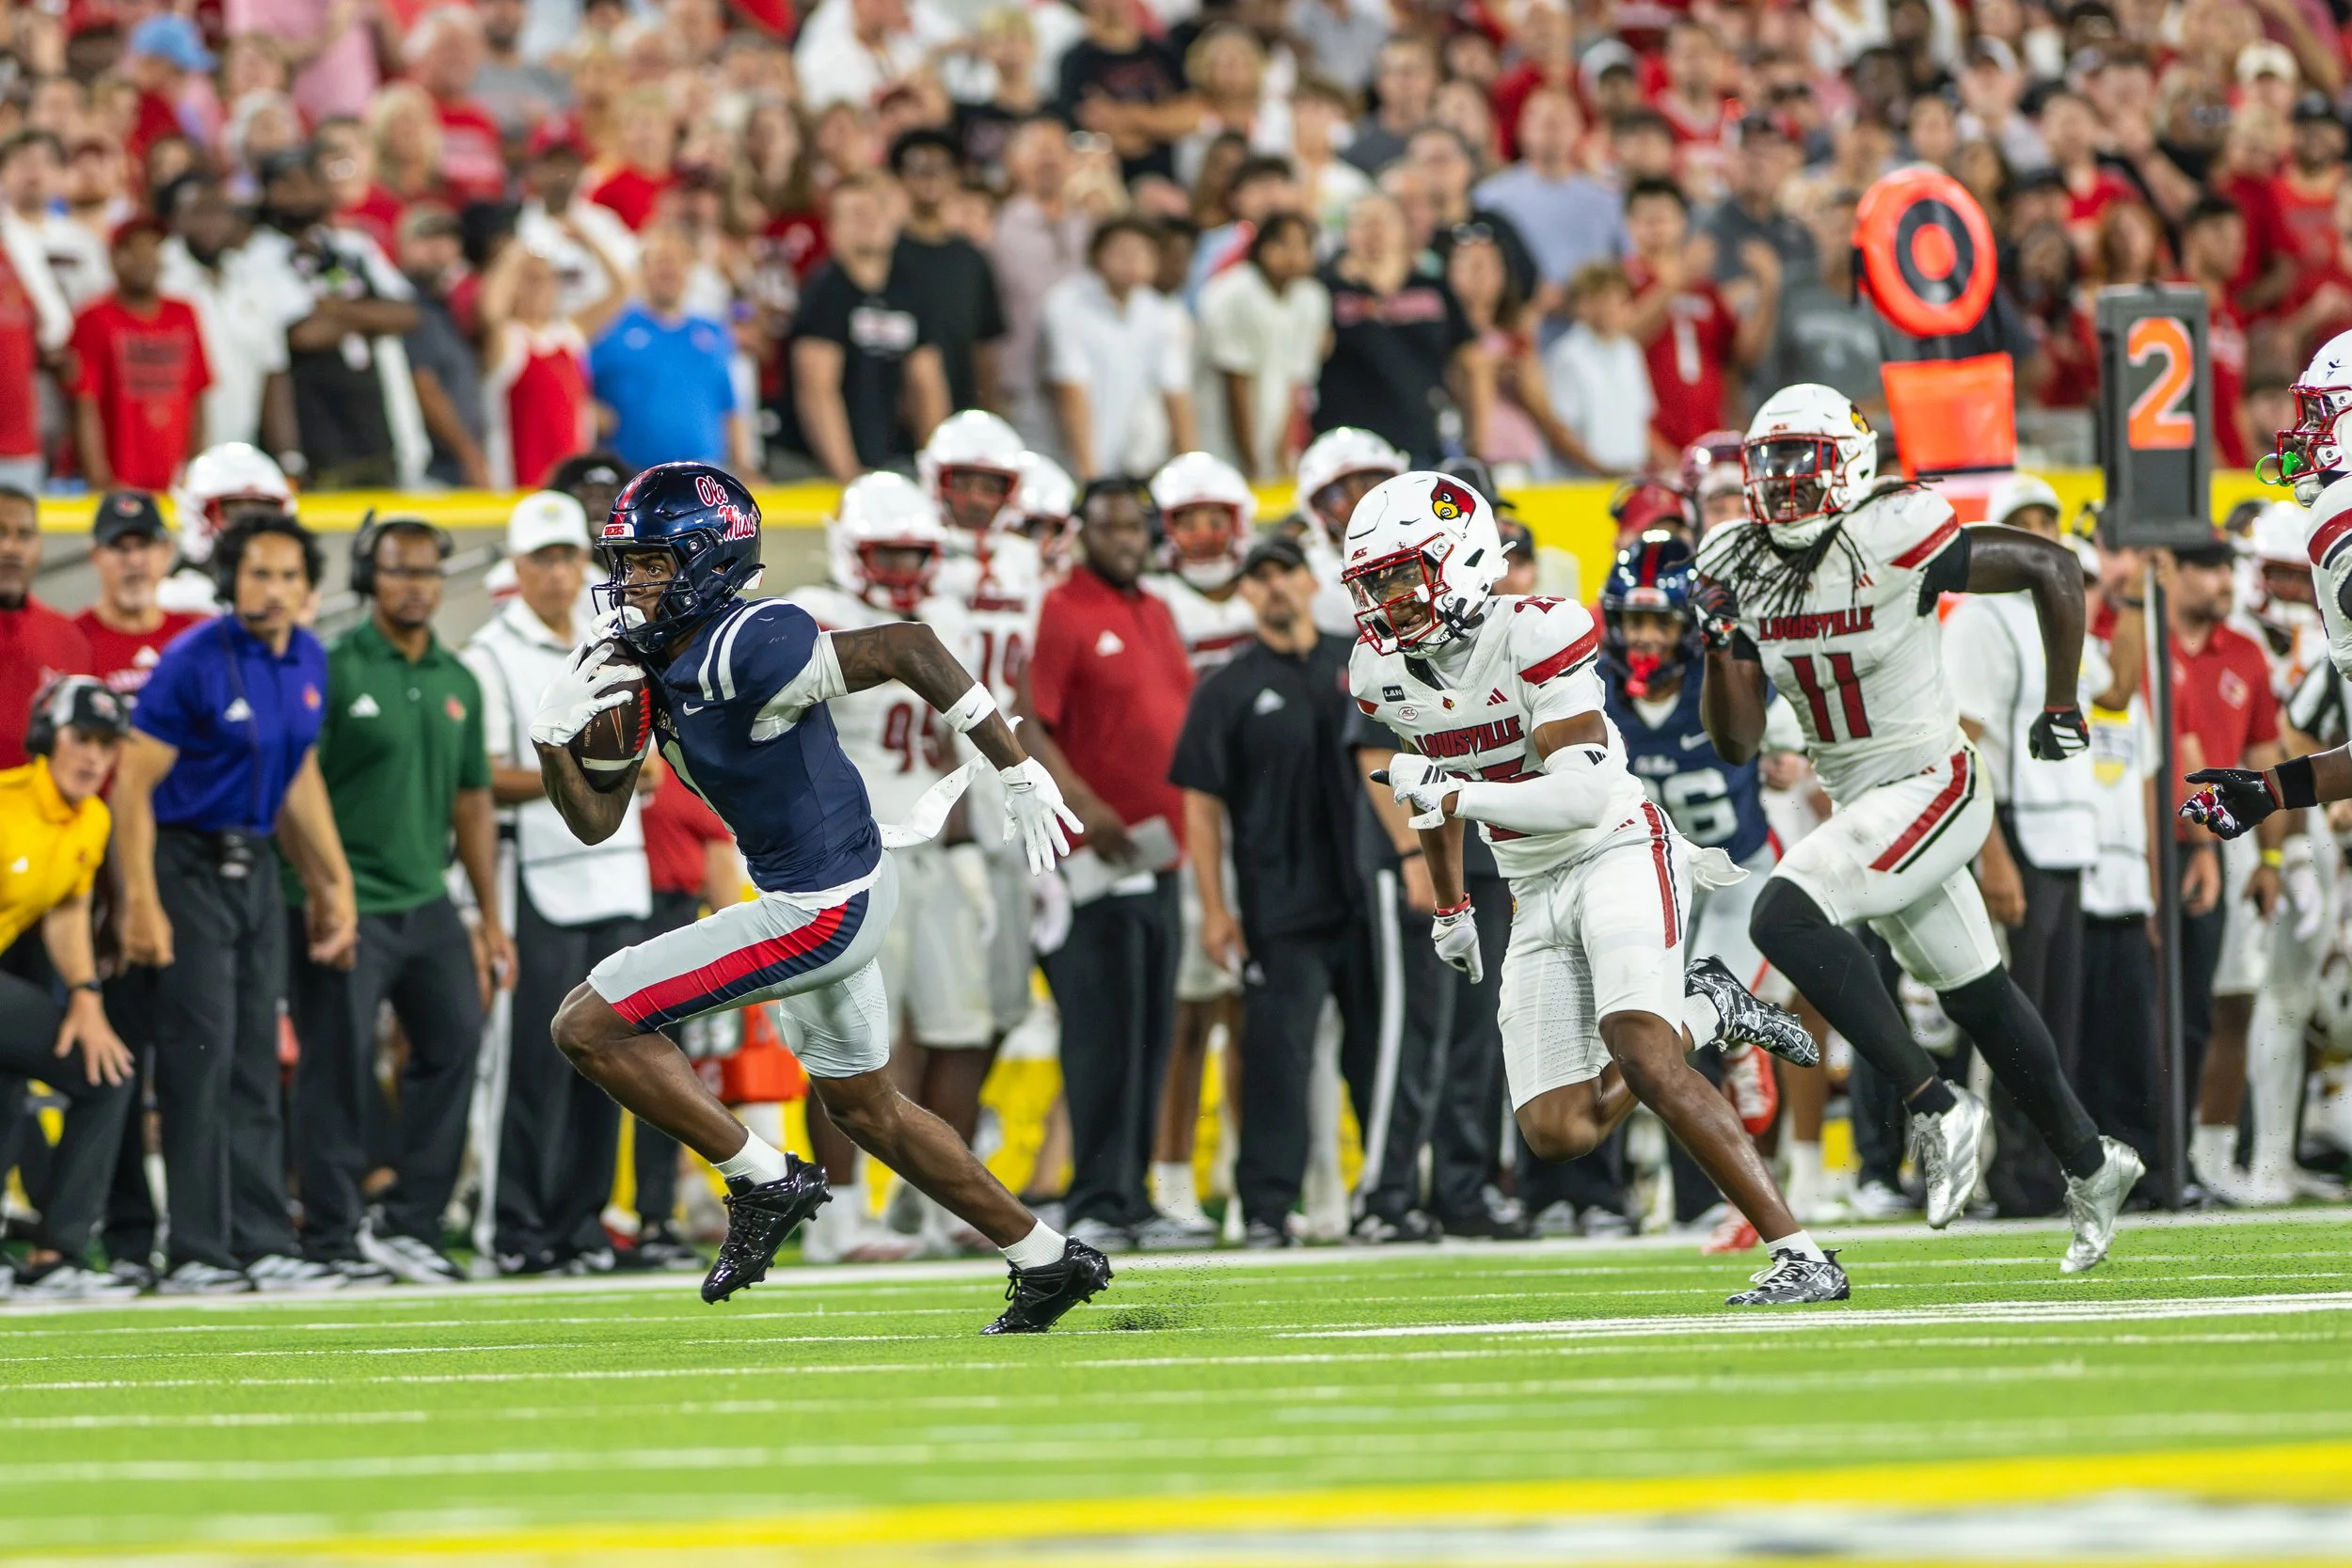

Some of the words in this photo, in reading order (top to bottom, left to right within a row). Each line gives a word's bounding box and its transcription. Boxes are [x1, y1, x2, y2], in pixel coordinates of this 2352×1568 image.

[2128, 316, 2196, 451] 2
[695, 476, 728, 507] Ole
[718, 504, 757, 542] Miss
[1758, 605, 1875, 641] LOUISVILLE
[1384, 689, 1403, 699] L&N
[1782, 652, 1872, 743] 11
[1413, 715, 1526, 758] LOUISVILLE
